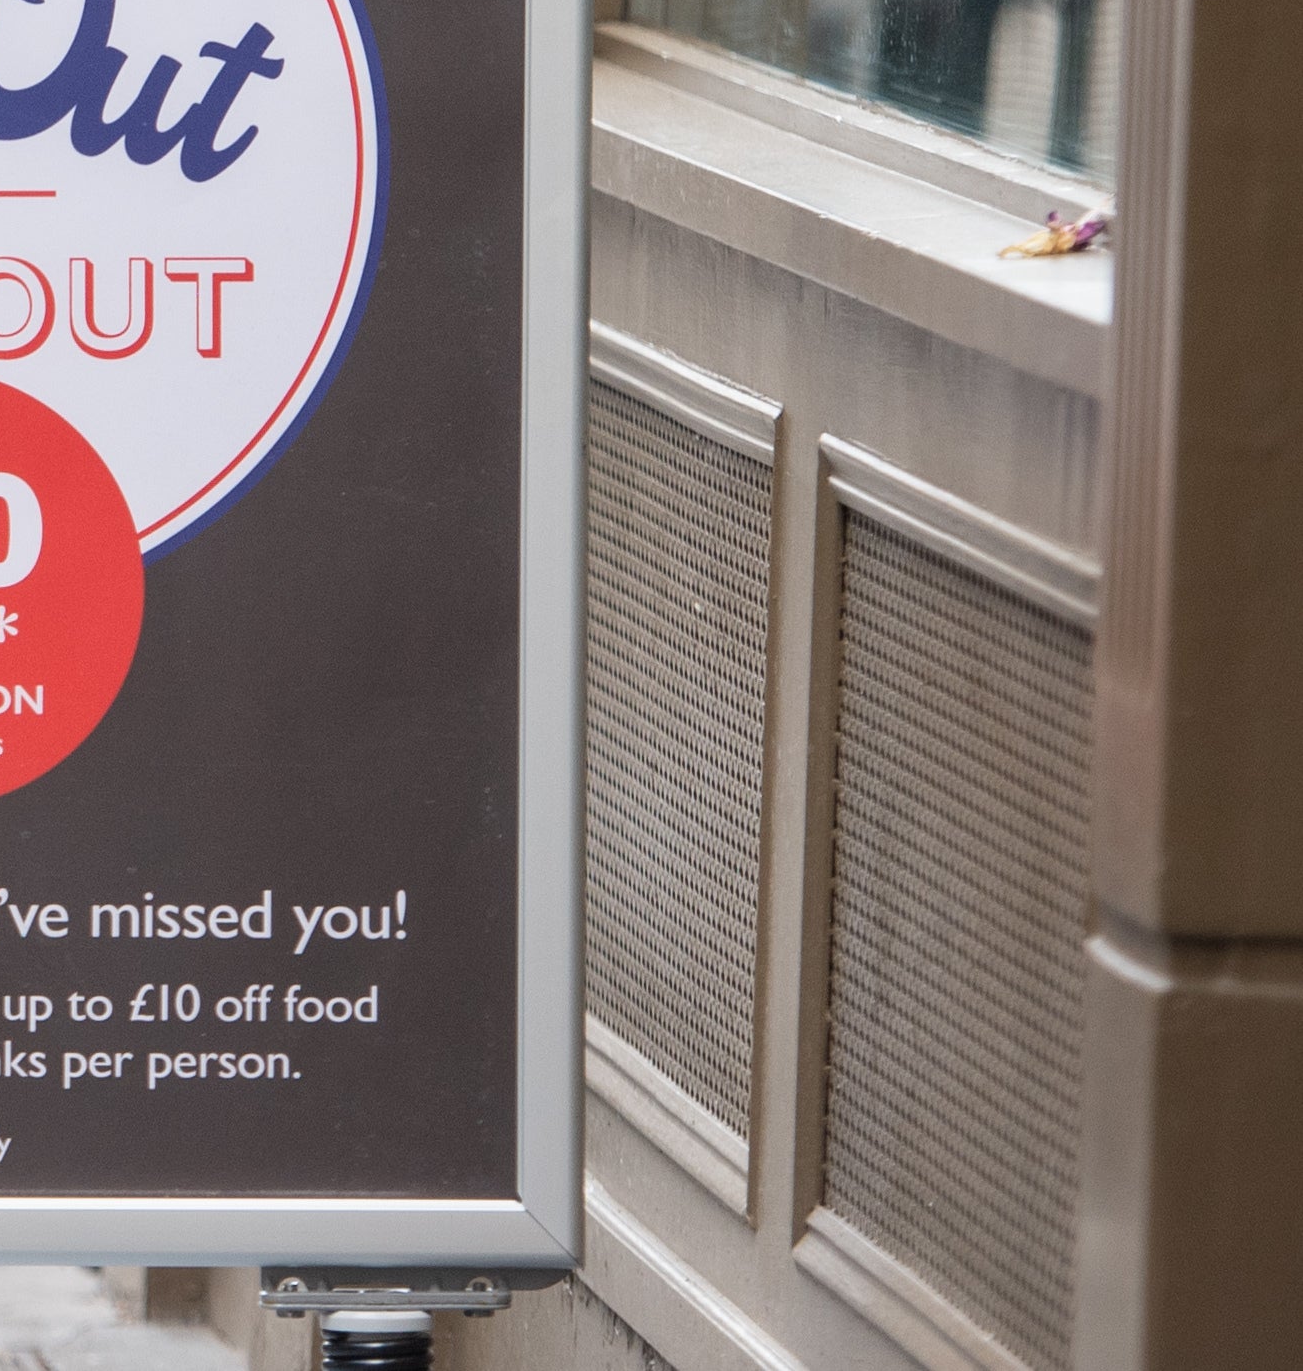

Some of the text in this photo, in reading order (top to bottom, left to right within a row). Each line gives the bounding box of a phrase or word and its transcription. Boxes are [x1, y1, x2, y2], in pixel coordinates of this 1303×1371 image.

[92, 890, 273, 940] missed
[293, 890, 409, 955] you!
[4, 995, 54, 1034] up
[68, 992, 114, 1023] to
[130, 984, 202, 1023] £10
[216, 984, 275, 1023] off
[284, 985, 379, 1024] food
[64, 1052, 135, 1091] per
[149, 1052, 303, 1091] person.
